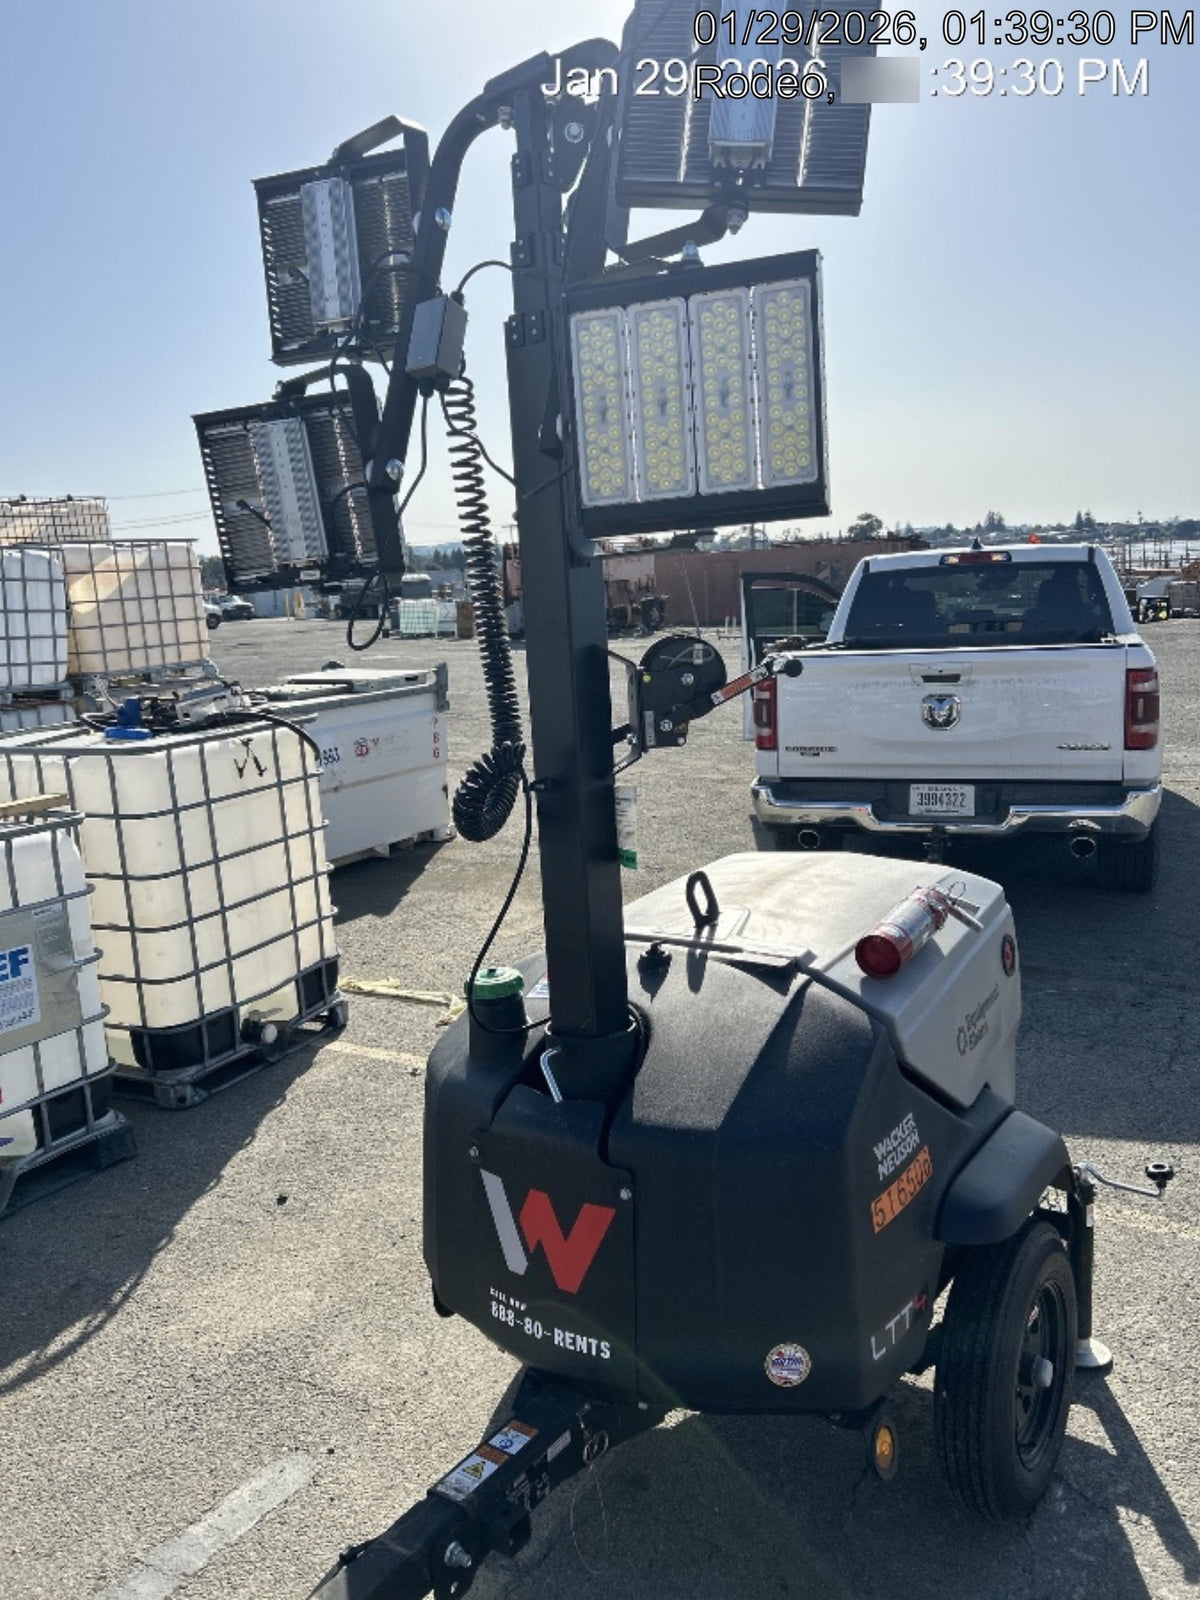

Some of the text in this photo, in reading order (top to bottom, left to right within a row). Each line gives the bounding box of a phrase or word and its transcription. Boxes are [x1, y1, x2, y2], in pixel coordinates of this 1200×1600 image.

[873, 1112, 917, 1160] WACKER
[878, 1128, 920, 1182] NEUSON
[490, 1300, 612, 1359] 888-80-RENTS
